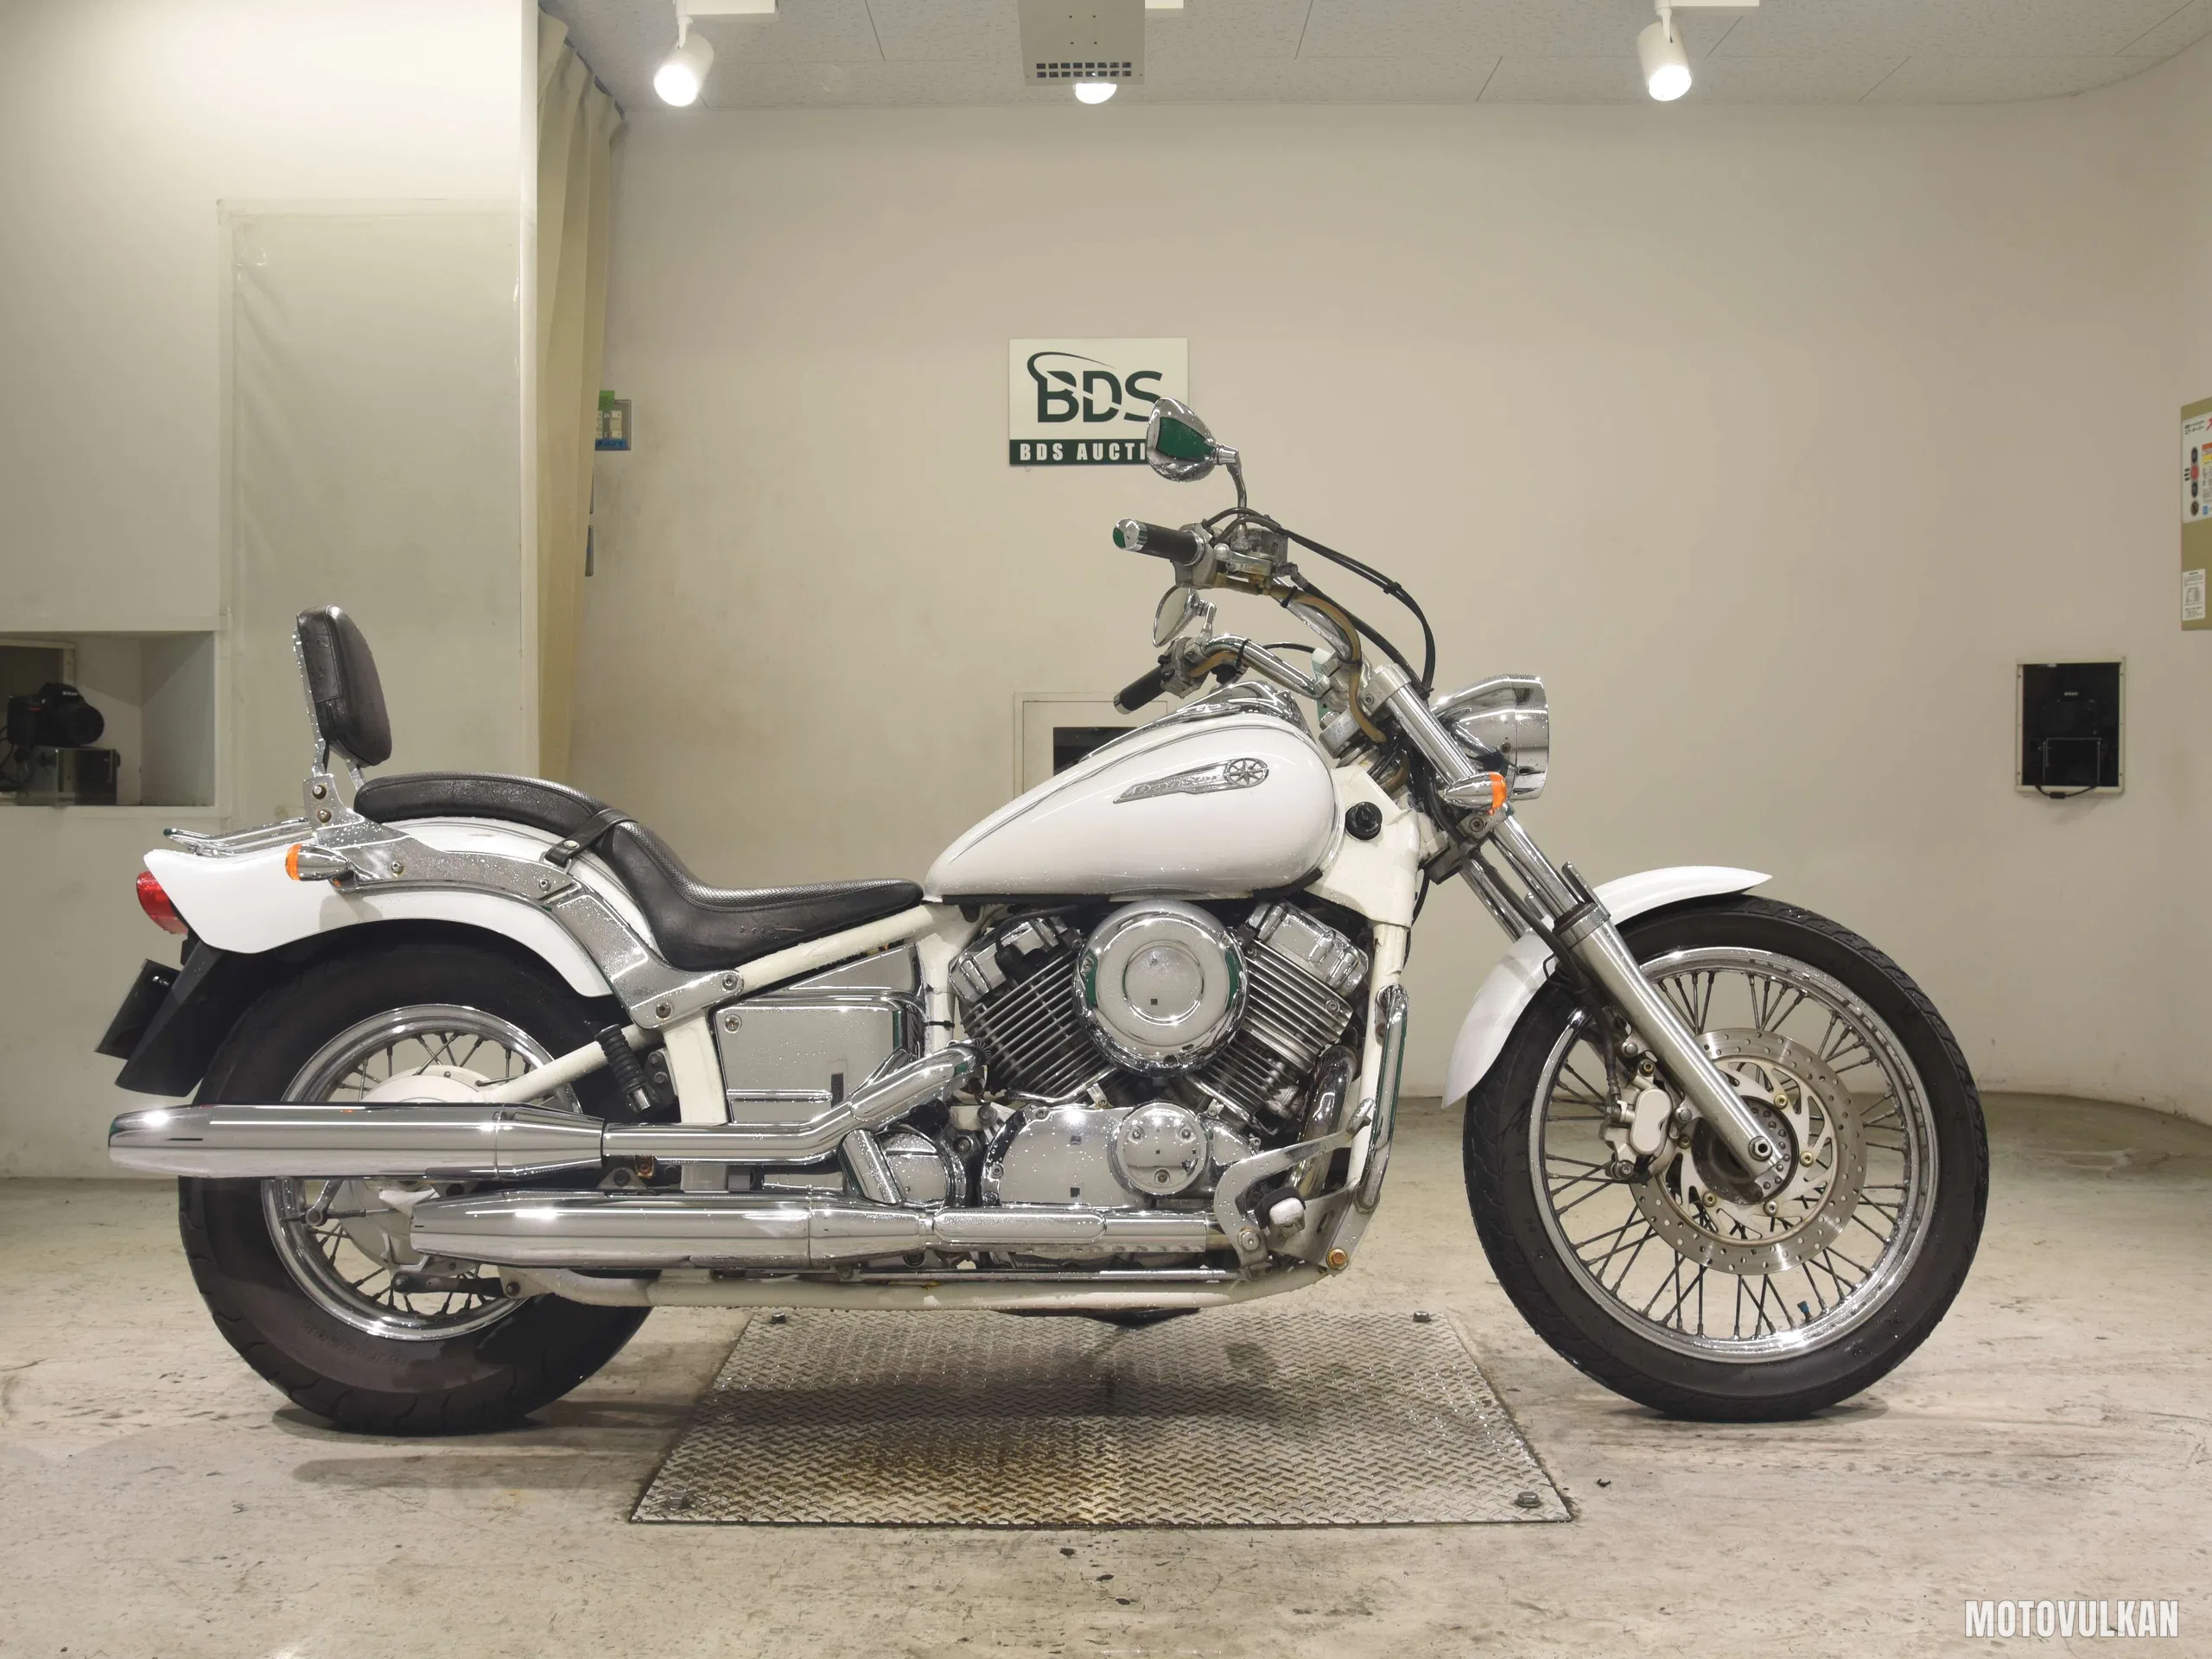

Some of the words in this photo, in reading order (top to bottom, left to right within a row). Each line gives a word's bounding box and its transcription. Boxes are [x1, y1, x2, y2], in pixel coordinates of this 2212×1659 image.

[1027, 352, 1163, 423] BDS
[1020, 442, 1064, 461] BDS
[1077, 442, 1146, 461] AUCTI
